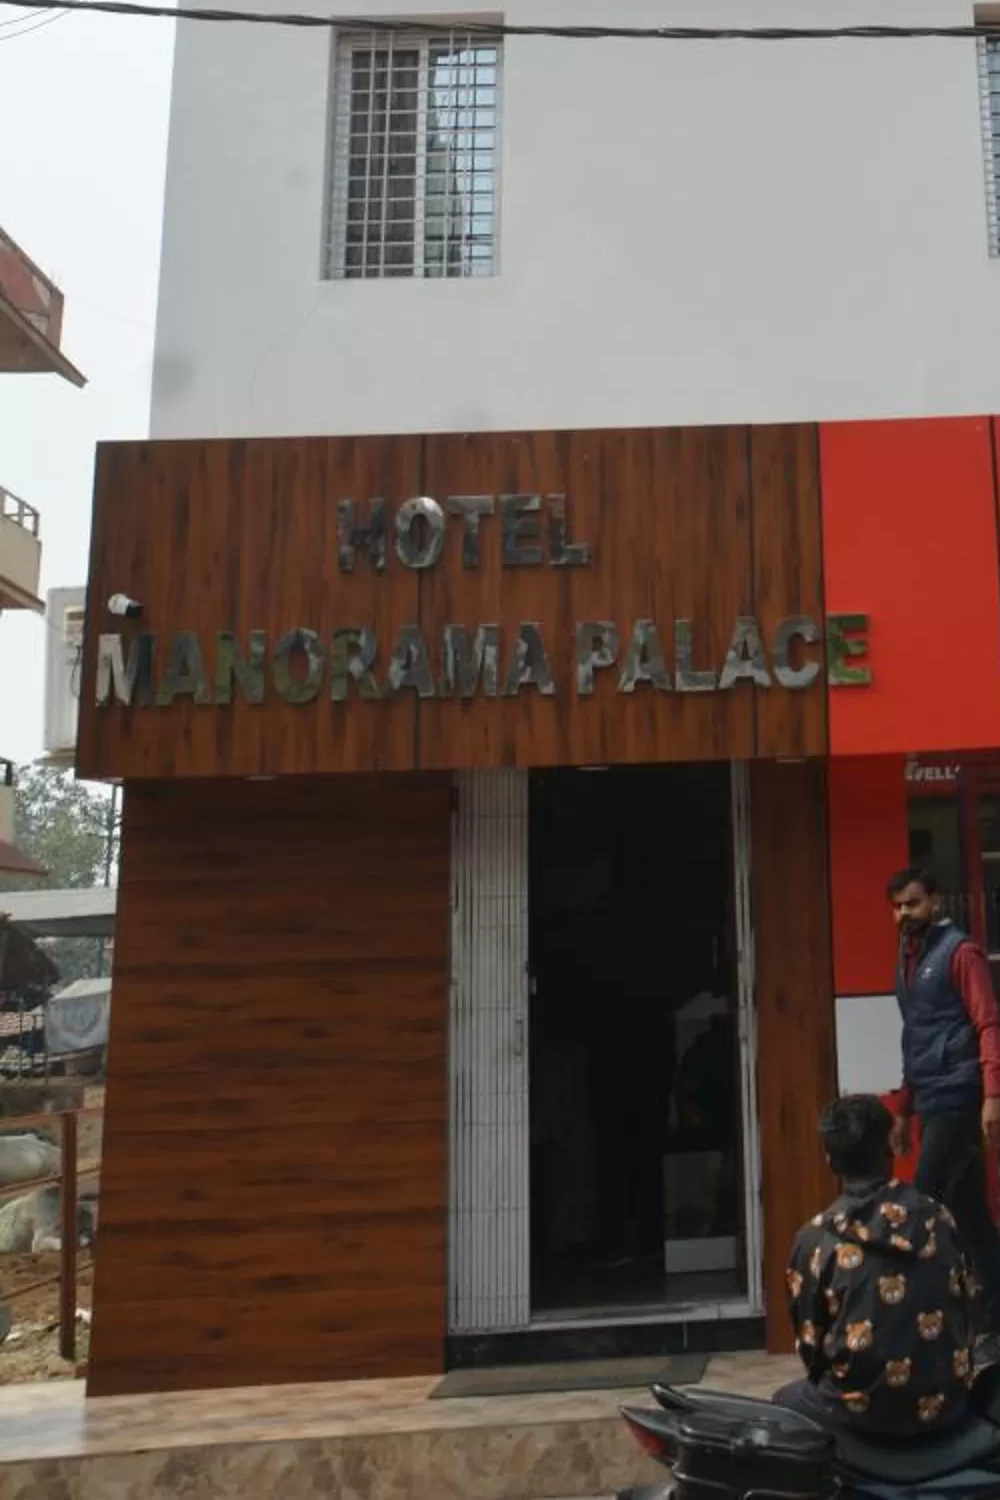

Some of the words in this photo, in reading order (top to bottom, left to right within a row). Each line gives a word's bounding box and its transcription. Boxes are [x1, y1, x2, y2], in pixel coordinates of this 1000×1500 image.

[337, 492, 591, 572] HOTEL
[95, 620, 557, 708] MANORAMA
[575, 612, 873, 695] PALACE
